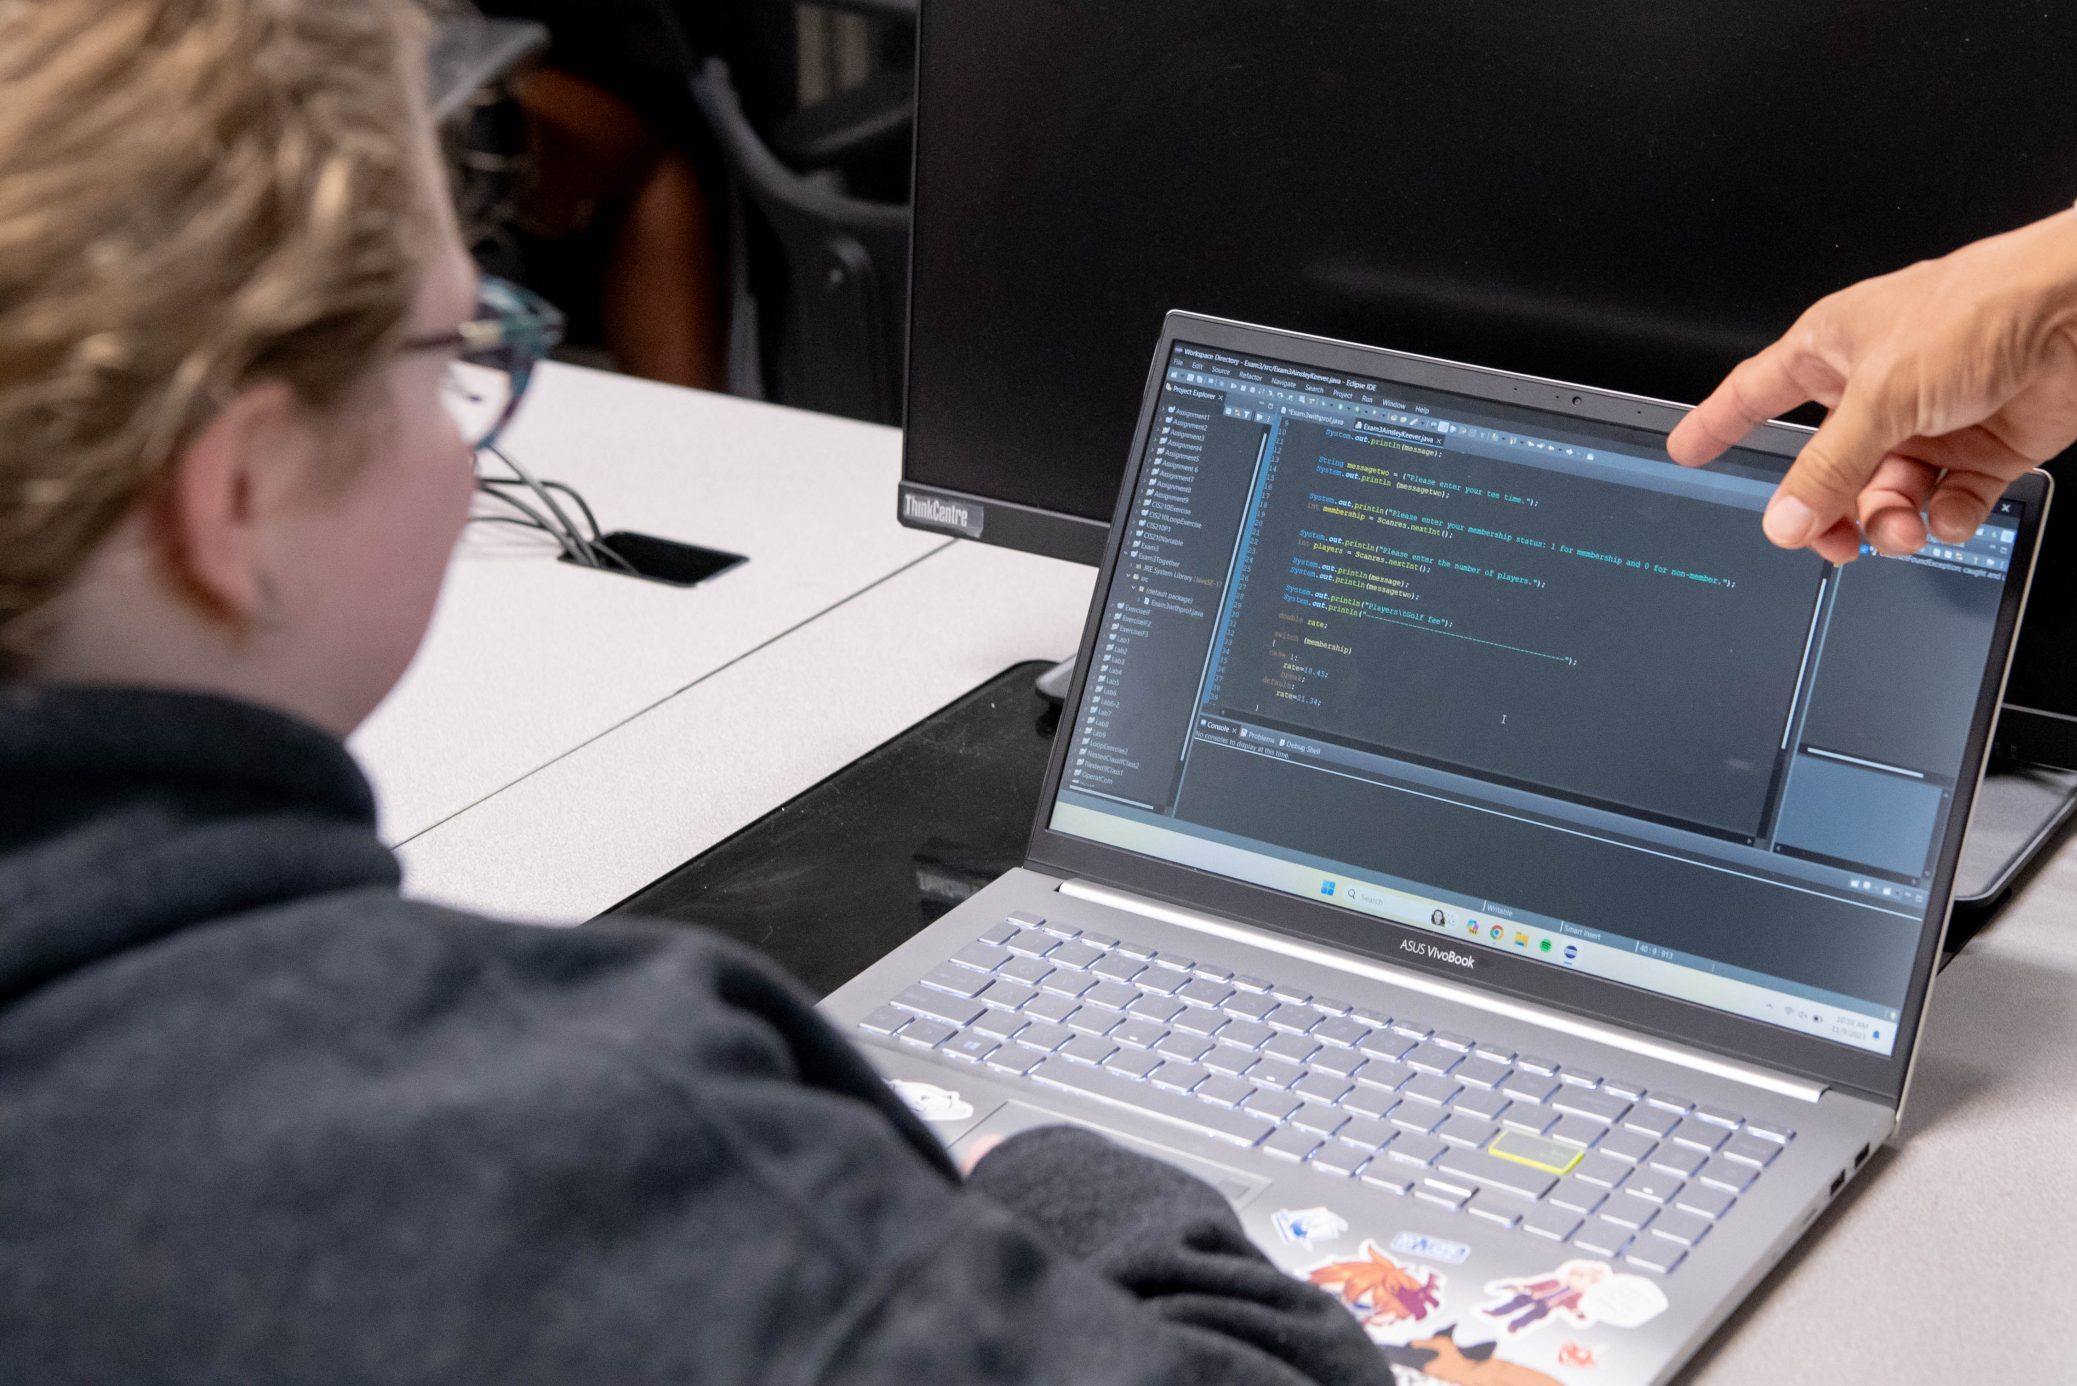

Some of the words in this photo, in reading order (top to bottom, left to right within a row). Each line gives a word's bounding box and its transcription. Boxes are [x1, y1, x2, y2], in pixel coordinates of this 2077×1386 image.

[1173, 358, 1183, 366] File
[1191, 361, 1203, 370] Edit
[1183, 348, 1214, 360] Workspace
[1214, 354, 1239, 366] Directory
[1345, 379, 1365, 390] Eclipse
[1365, 383, 1376, 391] IDE
[1211, 365, 1230, 375] Source
[1238, 371, 1262, 381] Refactor
[1270, 377, 1296, 389] Navigate
[1304, 384, 1324, 393] Search
[1172, 385, 1192, 396] Project
[1192, 389, 1216, 400] Explorer
[1332, 389, 1353, 400] Project
[1361, 395, 1373, 403] Run
[1381, 399, 1406, 410] Window
[1414, 405, 1430, 415] Help
[905, 493, 968, 528] ThinkCentre
[1206, 721, 1230, 732] Console
[1248, 731, 1275, 743] Problems
[1204, 732, 1229, 743] consoles
[1236, 740, 1259, 752] display
[1264, 747, 1274, 755] this
[1285, 740, 1306, 752] Debug
[1563, 924, 1582, 936] Smart
[1400, 939, 1426, 955] ASUS
[1428, 945, 1475, 969] VivoBook
